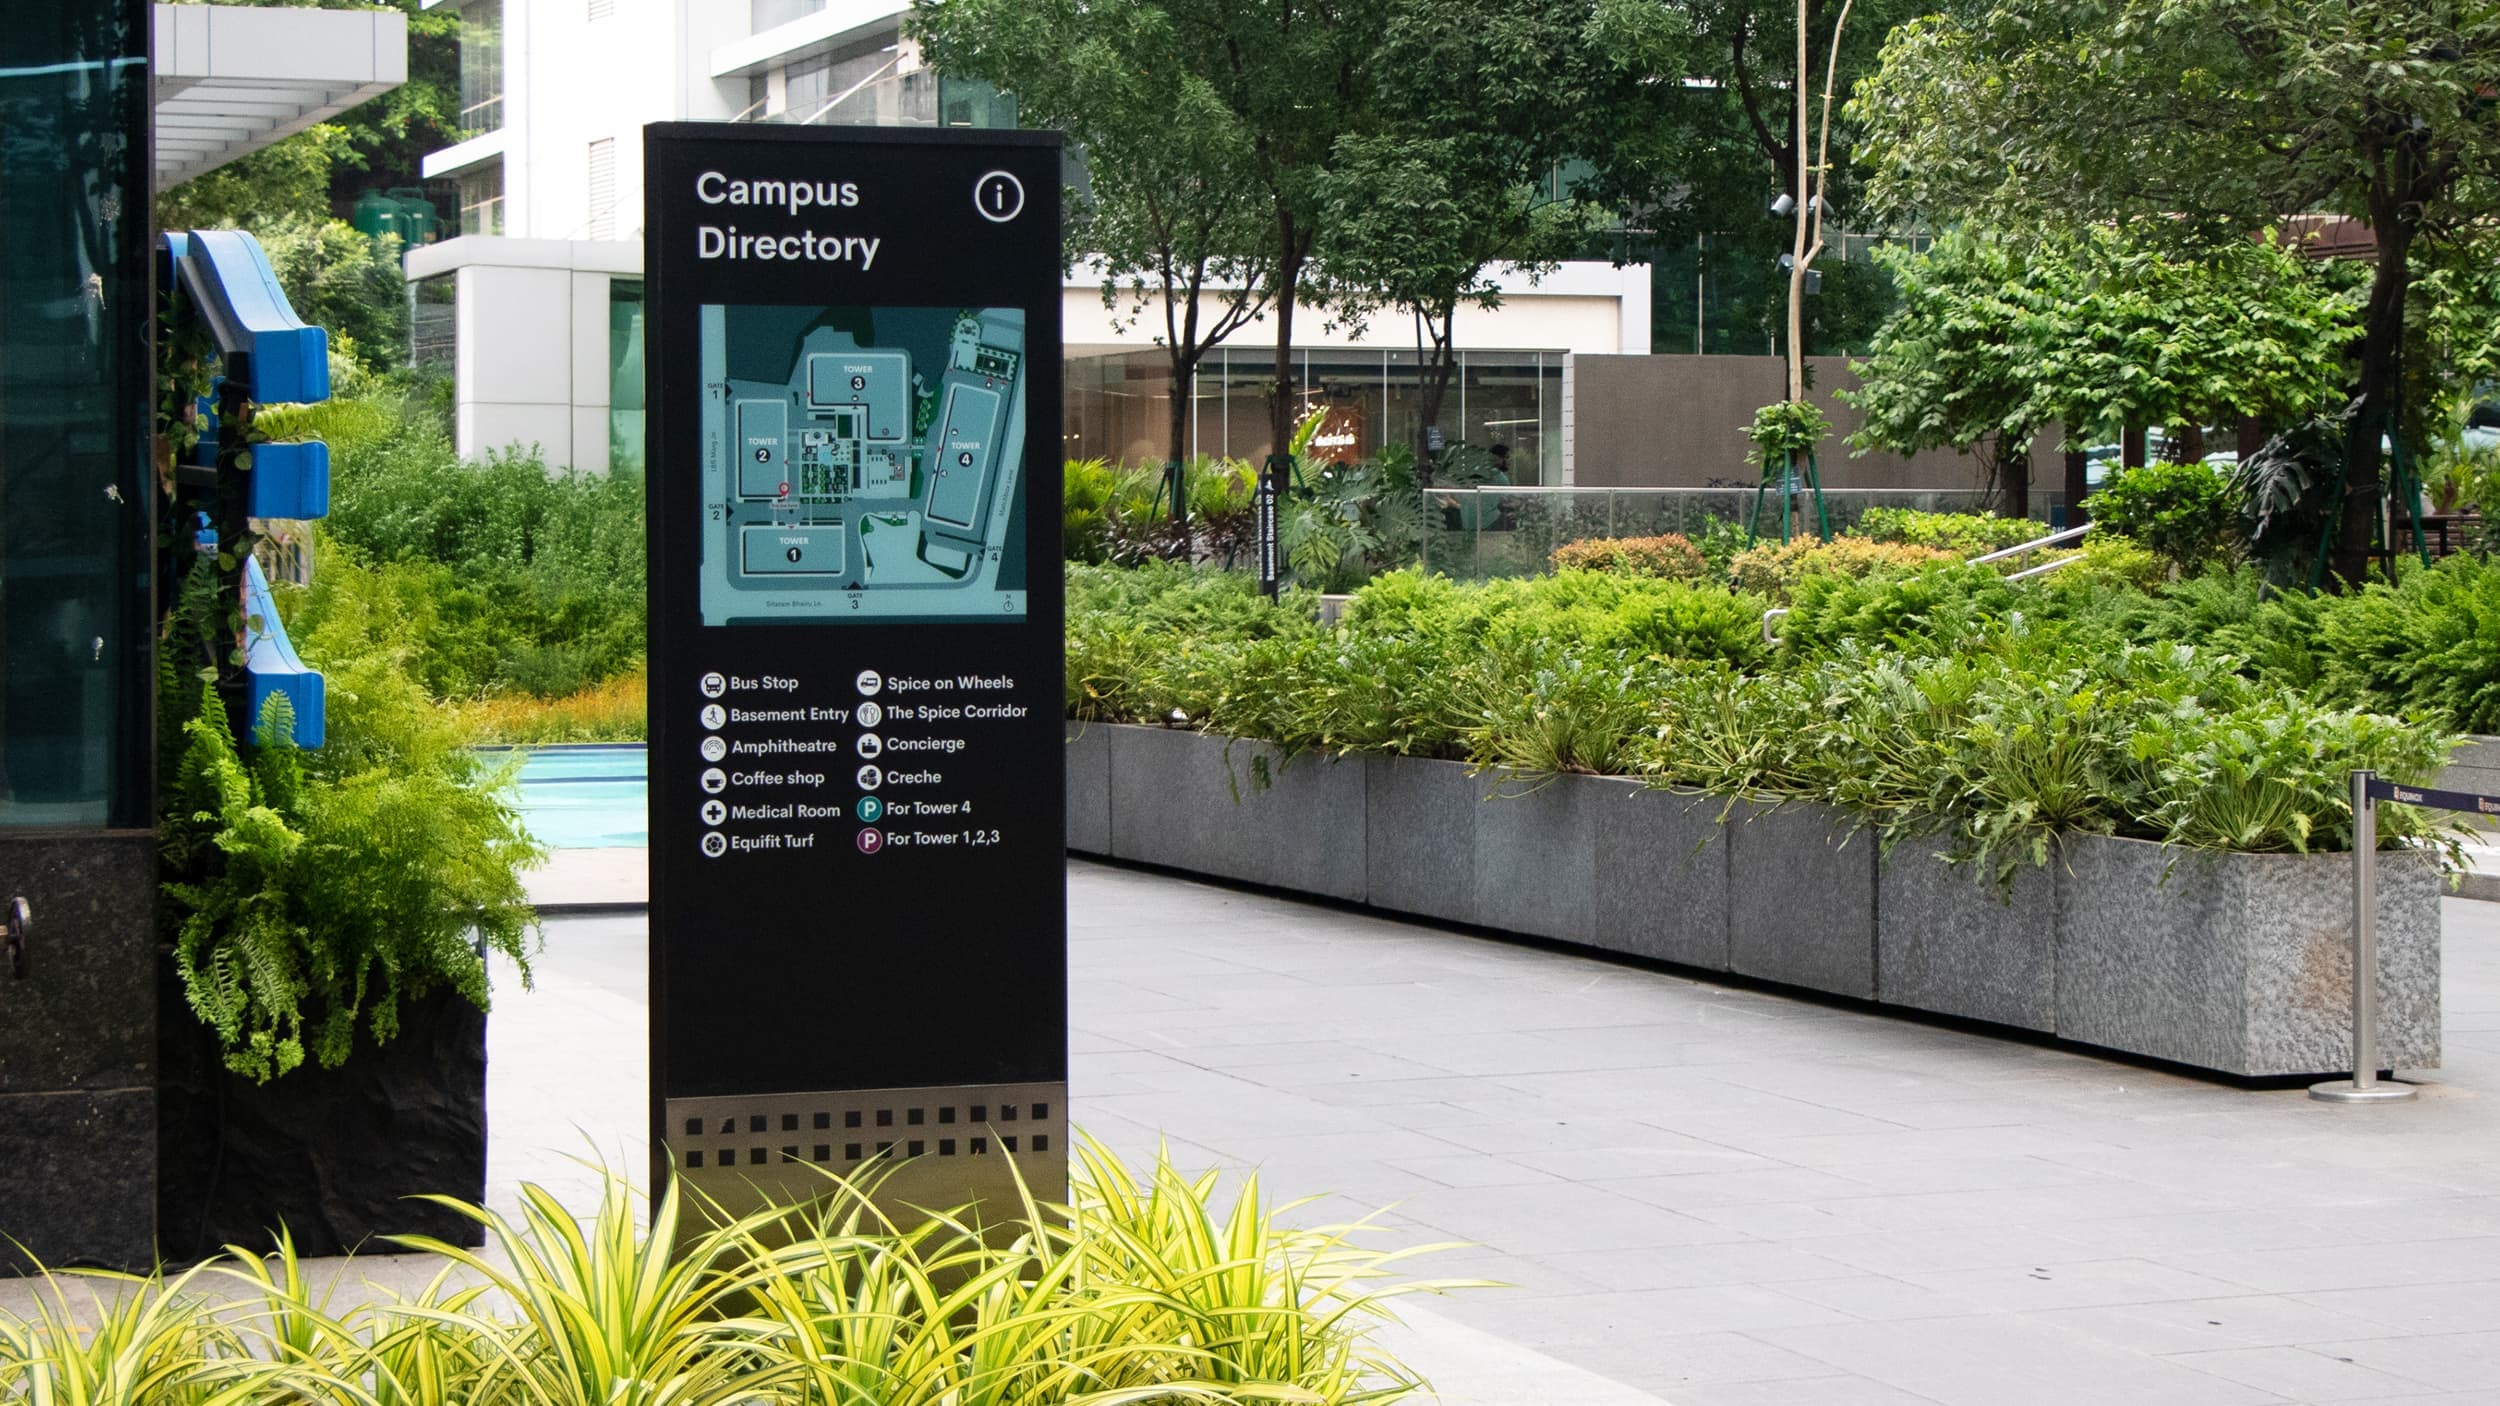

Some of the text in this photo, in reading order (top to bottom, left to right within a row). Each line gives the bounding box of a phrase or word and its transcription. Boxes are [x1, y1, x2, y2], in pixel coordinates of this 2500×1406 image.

[697, 171, 859, 215] Campus
[699, 227, 880, 270] Directory
[843, 365, 873, 373] TOWER
[854, 378, 862, 389] 3
[712, 390, 718, 400] 1
[748, 438, 778, 446] TOWER
[951, 442, 981, 450] TOWER
[759, 450, 767, 461] 2
[961, 454, 970, 465] 4
[713, 511, 720, 520] 2
[779, 537, 809, 545] TOWER
[790, 550, 797, 561] 1
[991, 553, 998, 562] 4
[852, 600, 859, 609] 3
[731, 676, 799, 692] Bus Stop
[888, 675, 1014, 693] Spice on Wheels
[731, 707, 849, 723] Basement Entry
[887, 704, 1028, 722] The Spice Corridor
[732, 739, 837, 757] Amphitheatre
[887, 737, 965, 753] Concierge
[731, 771, 825, 787] Coffee shop
[887, 770, 942, 784] Creche
[732, 804, 841, 819] Medical Room
[864, 801, 877, 817] P
[887, 800, 971, 815] For Tower 4
[731, 833, 815, 852] Equifit Turf
[864, 834, 877, 849] P
[887, 830, 1000, 846] For Tower 1,2,3
